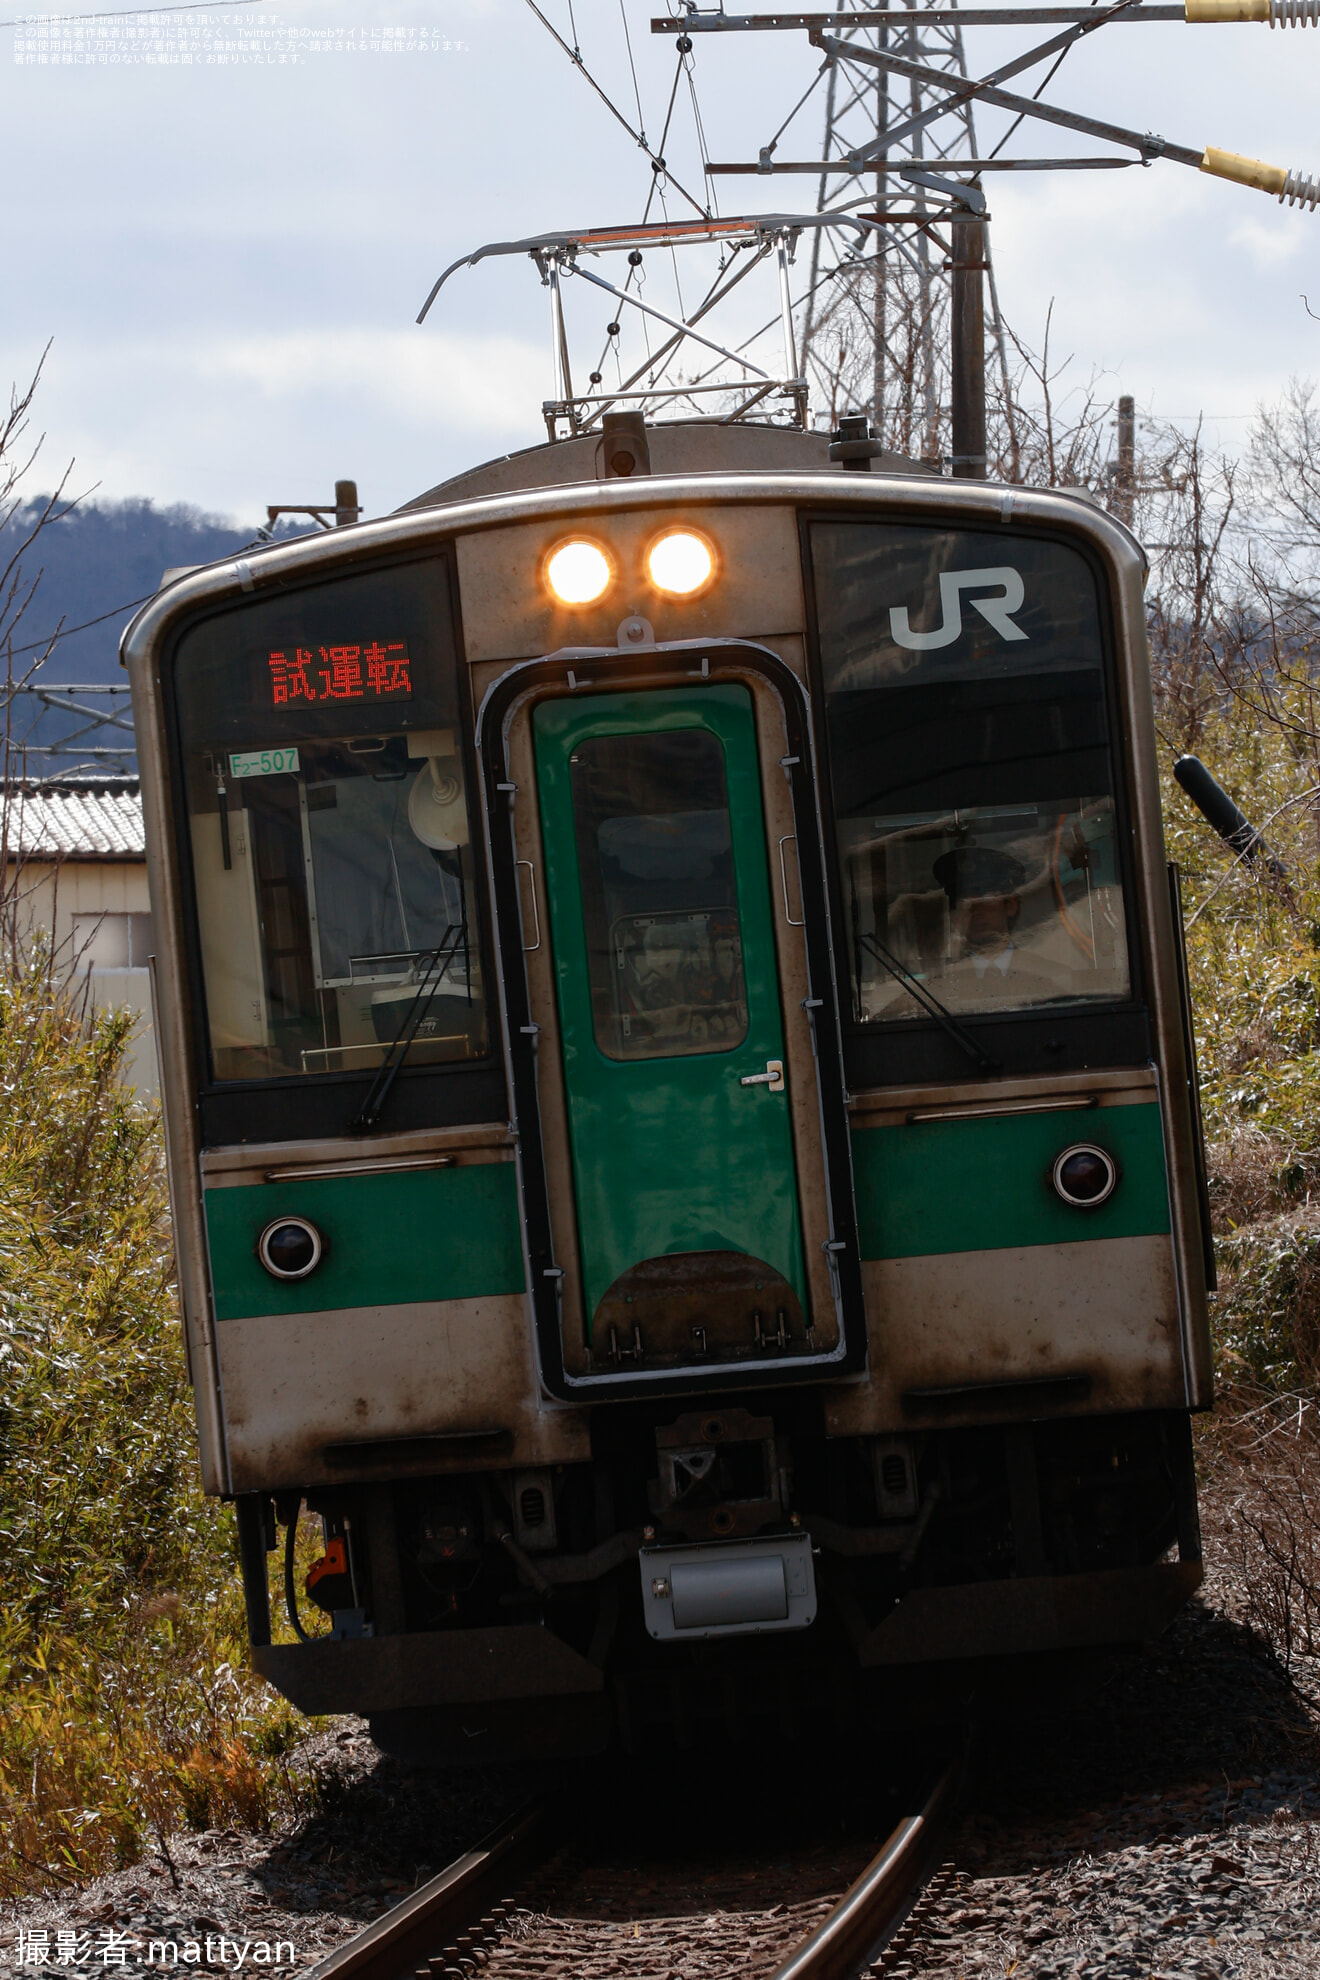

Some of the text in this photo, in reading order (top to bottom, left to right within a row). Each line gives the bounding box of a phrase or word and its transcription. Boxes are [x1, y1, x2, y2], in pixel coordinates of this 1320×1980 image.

[889, 566, 1030, 650] JR
[268, 642, 412, 703] 試運転
